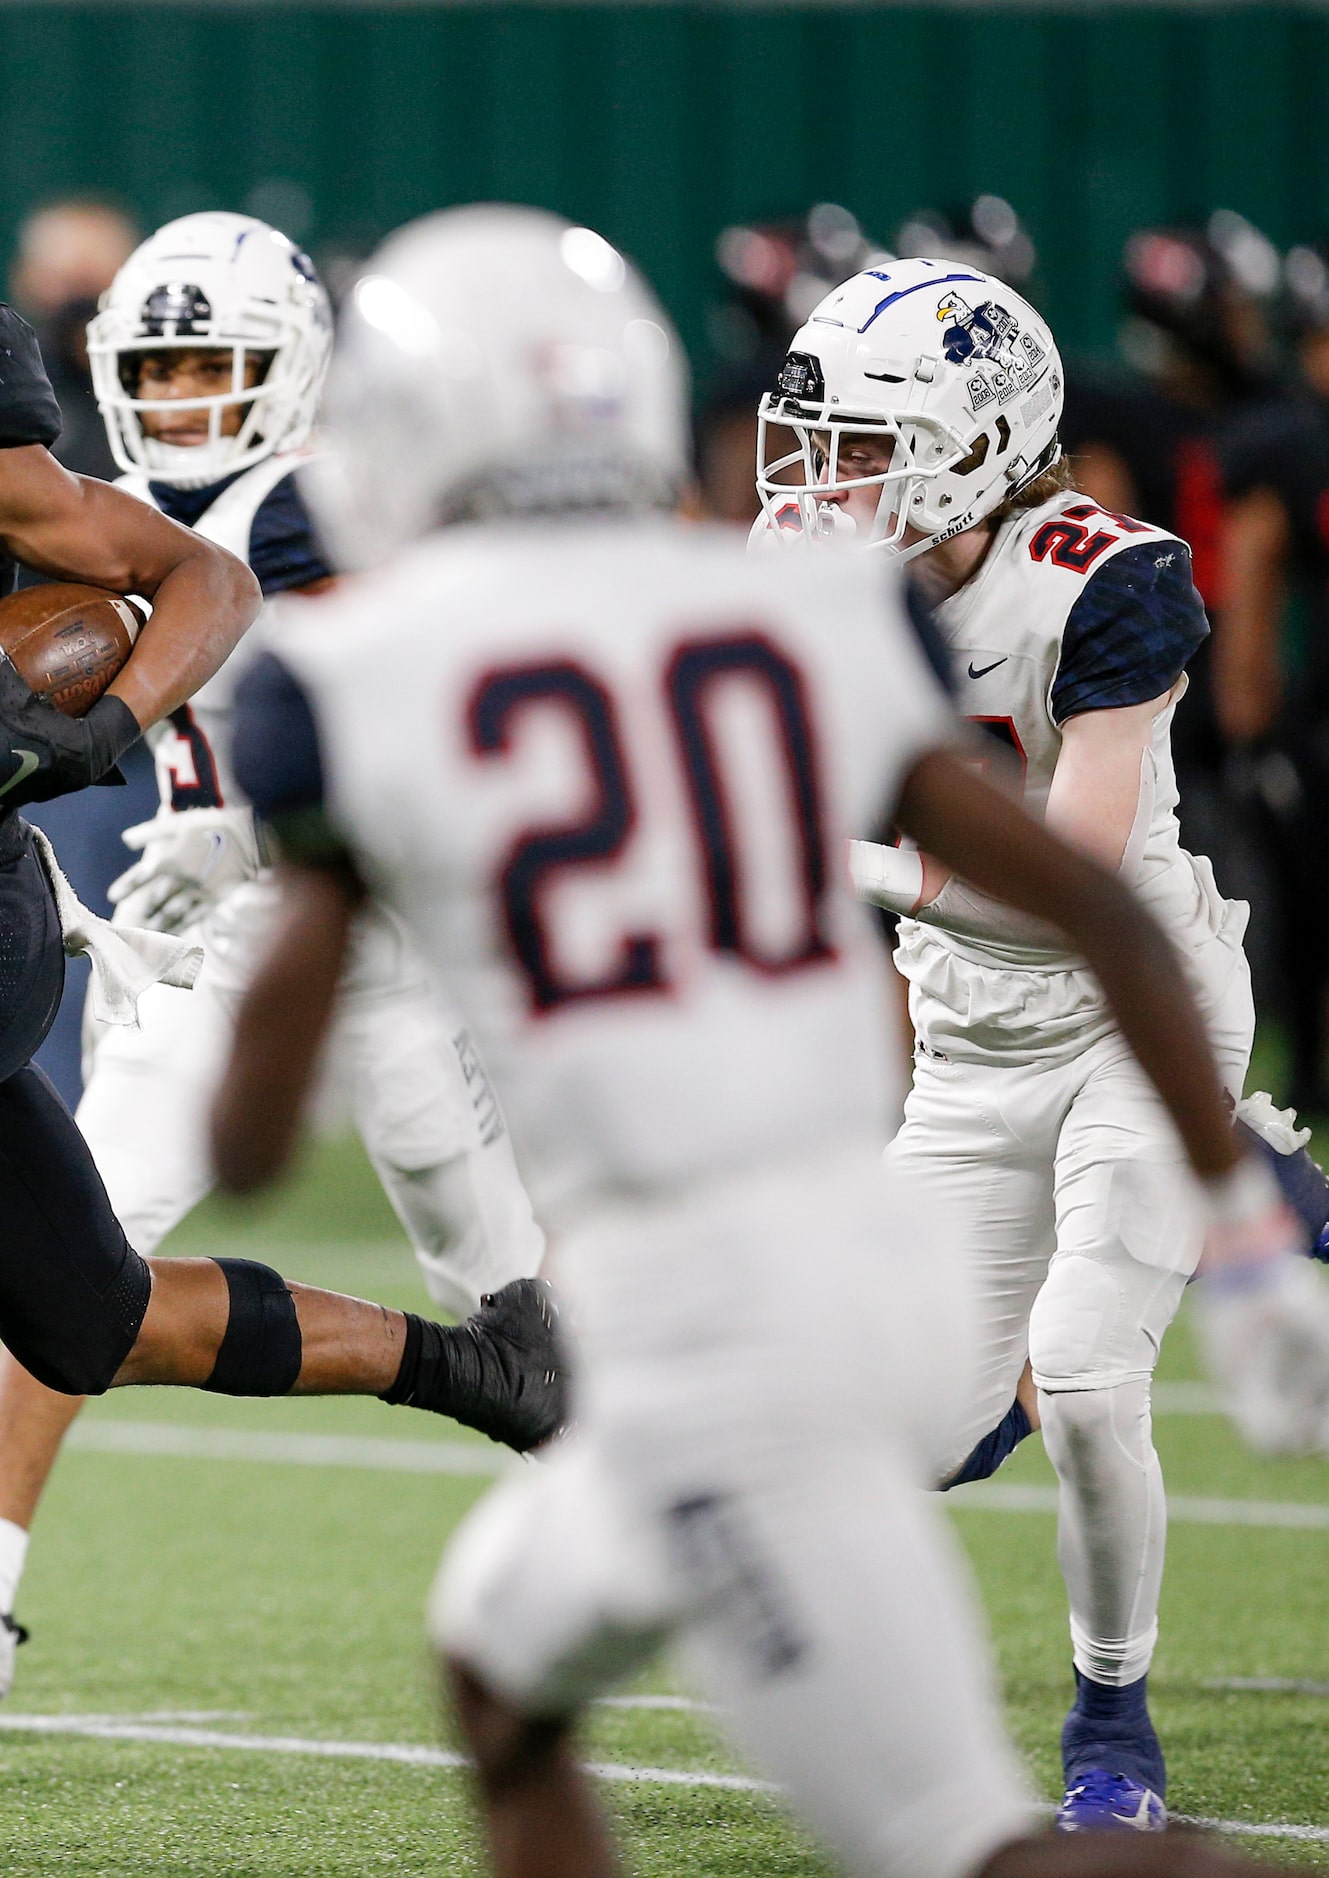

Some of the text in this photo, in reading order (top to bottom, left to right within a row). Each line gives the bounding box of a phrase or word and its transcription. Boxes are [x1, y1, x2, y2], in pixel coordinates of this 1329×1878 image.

[973, 390, 992, 406] 2008
[998, 384, 1015, 401] 2012
[931, 510, 975, 547] schutt
[468, 631, 840, 1022] 20
